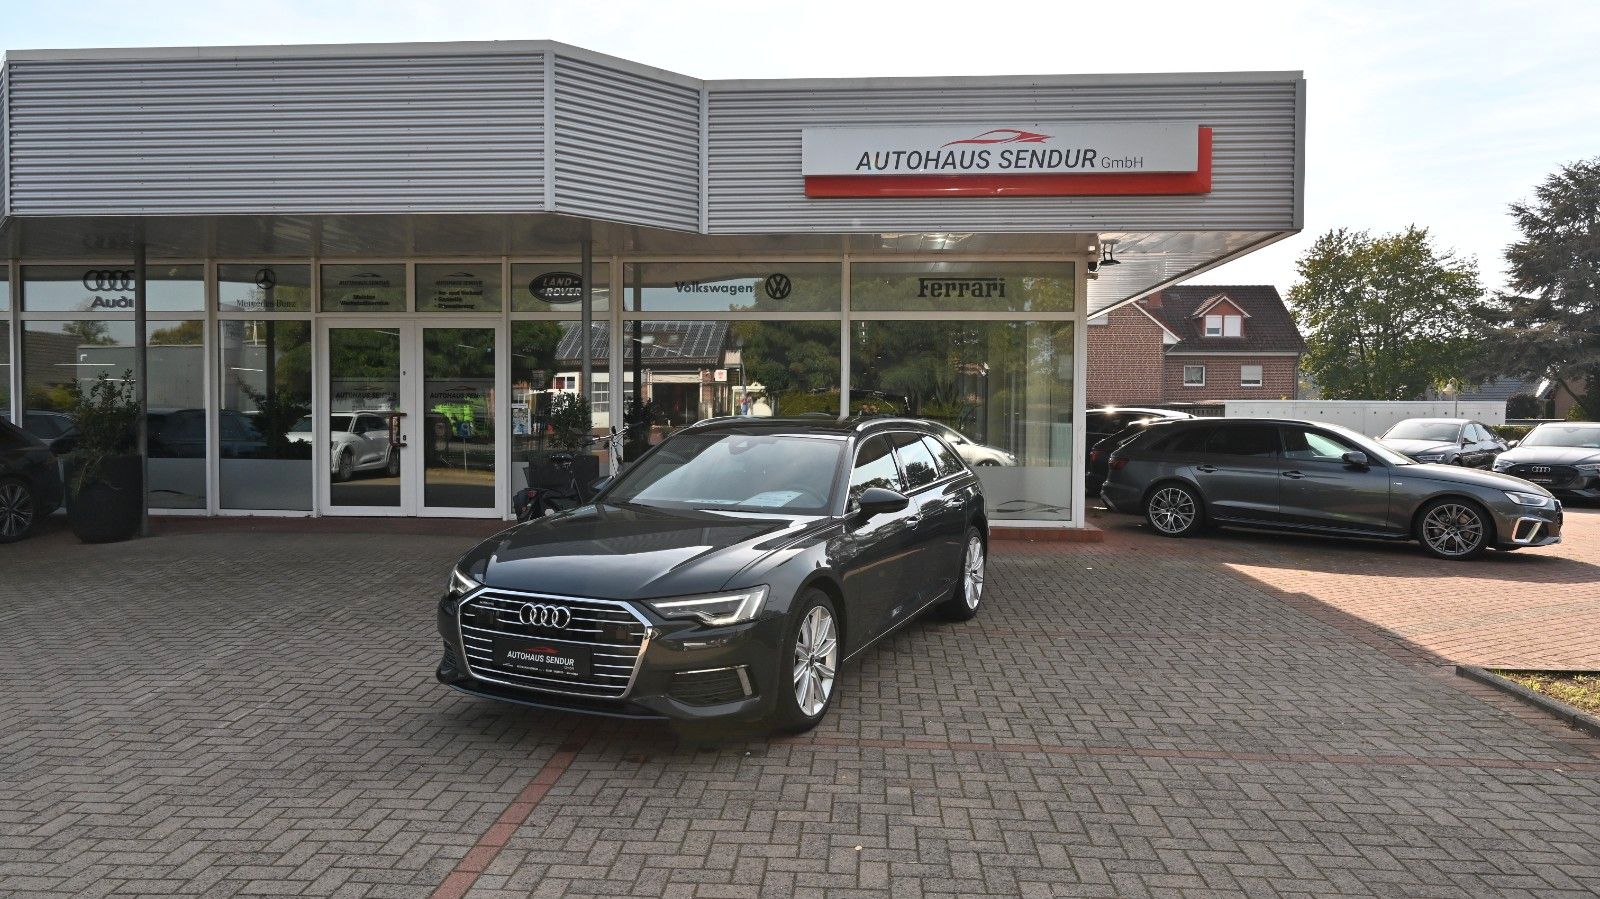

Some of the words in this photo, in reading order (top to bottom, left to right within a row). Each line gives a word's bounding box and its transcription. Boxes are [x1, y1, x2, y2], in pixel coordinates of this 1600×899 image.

[855, 150, 991, 171] AUTOHAUS
[998, 149, 1097, 169] SENDUR
[1101, 156, 1144, 169] GmbH
[545, 287, 582, 296] ROVER
[676, 282, 753, 295] Volkswagen
[917, 277, 1006, 298] Ferrari
[91, 296, 134, 308] Audi
[507, 650, 545, 663] AUTOHAUS
[545, 655, 575, 666] SENDUR
